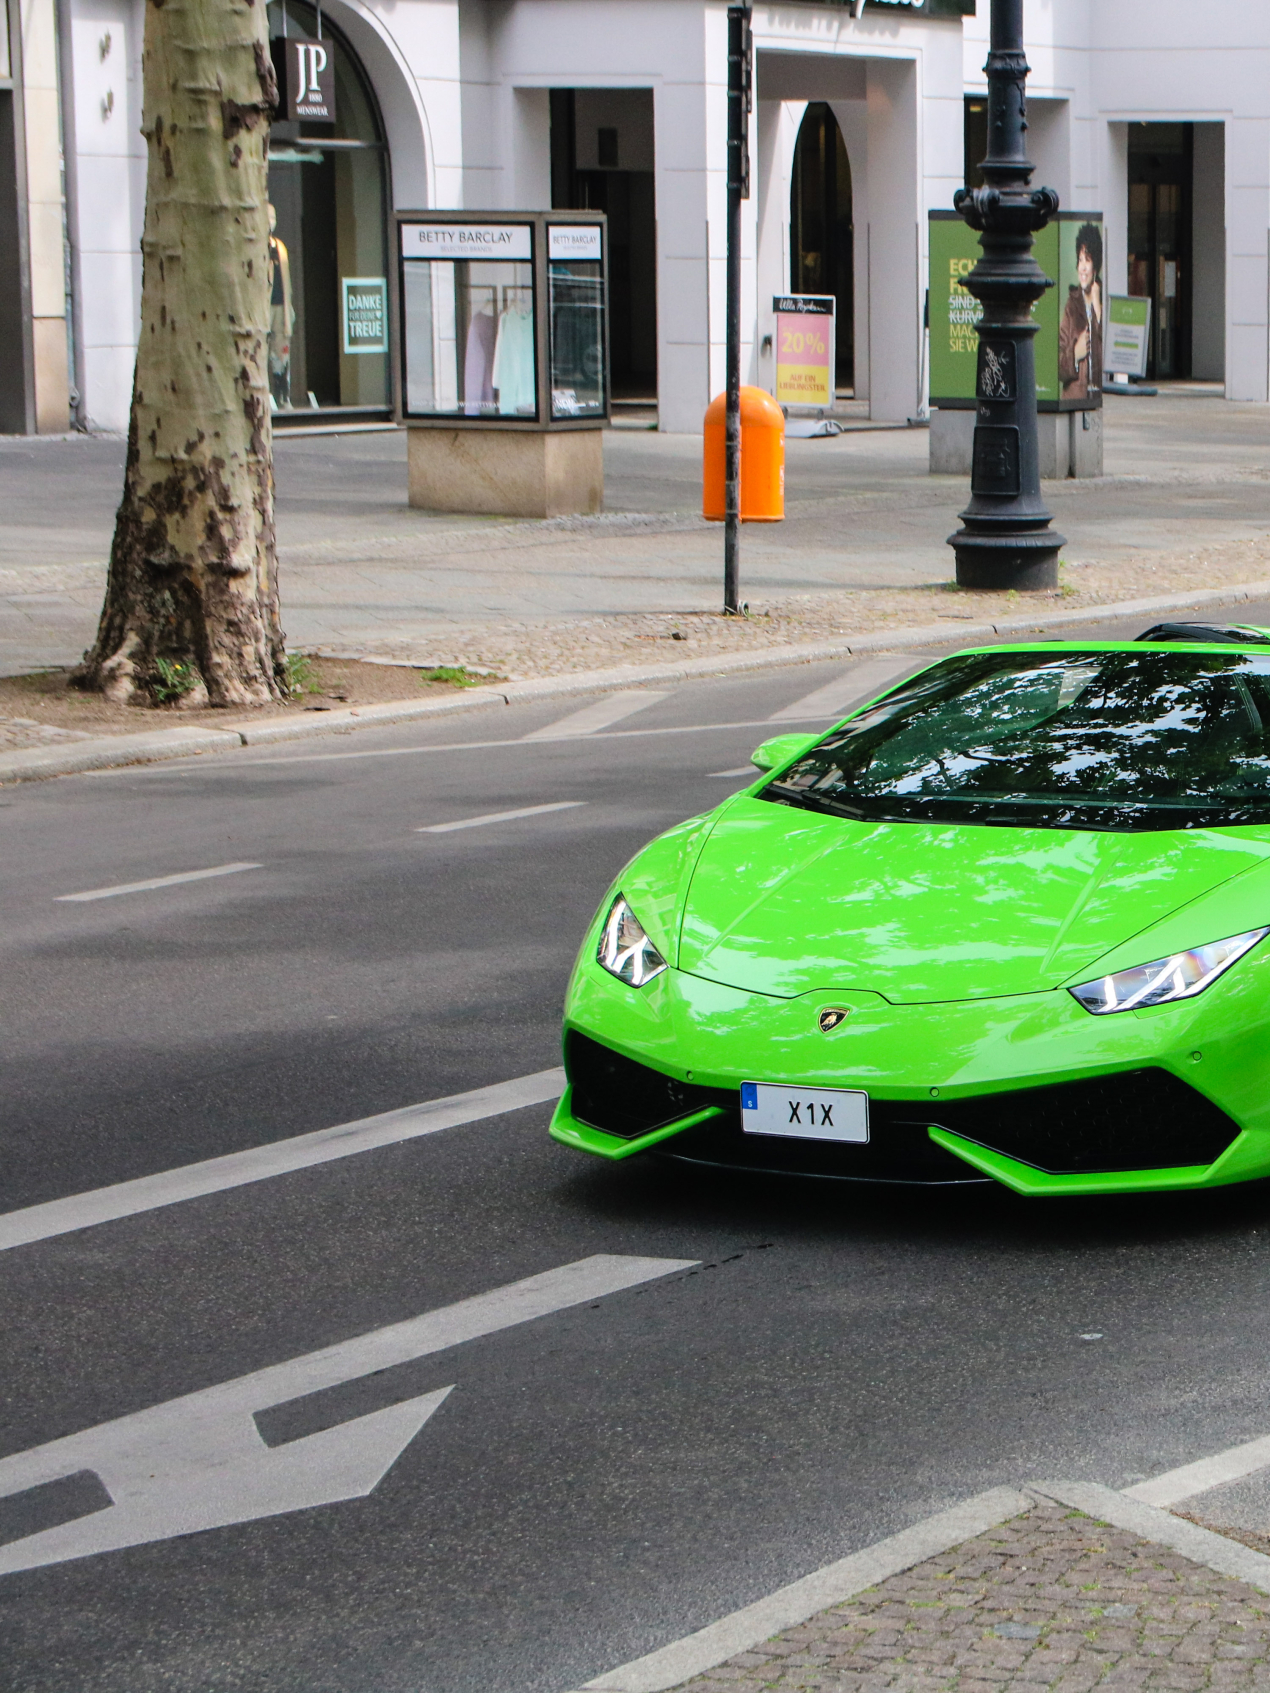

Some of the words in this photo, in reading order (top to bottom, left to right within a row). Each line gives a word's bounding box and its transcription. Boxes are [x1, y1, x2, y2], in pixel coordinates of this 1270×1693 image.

[295, 44, 327, 104] JP
[296, 105, 329, 116] MENSWEAR
[419, 230, 455, 244] BETTY
[459, 231, 513, 244] BARCLAY
[552, 235, 571, 245] BETTY
[572, 235, 597, 245] BARCLAY
[349, 294, 382, 310] DANKE
[949, 295, 975, 310] SIND
[349, 321, 383, 338] TREUE
[782, 332, 825, 355] 20%
[949, 339, 965, 352] SIE
[788, 1100, 834, 1127] X1X
